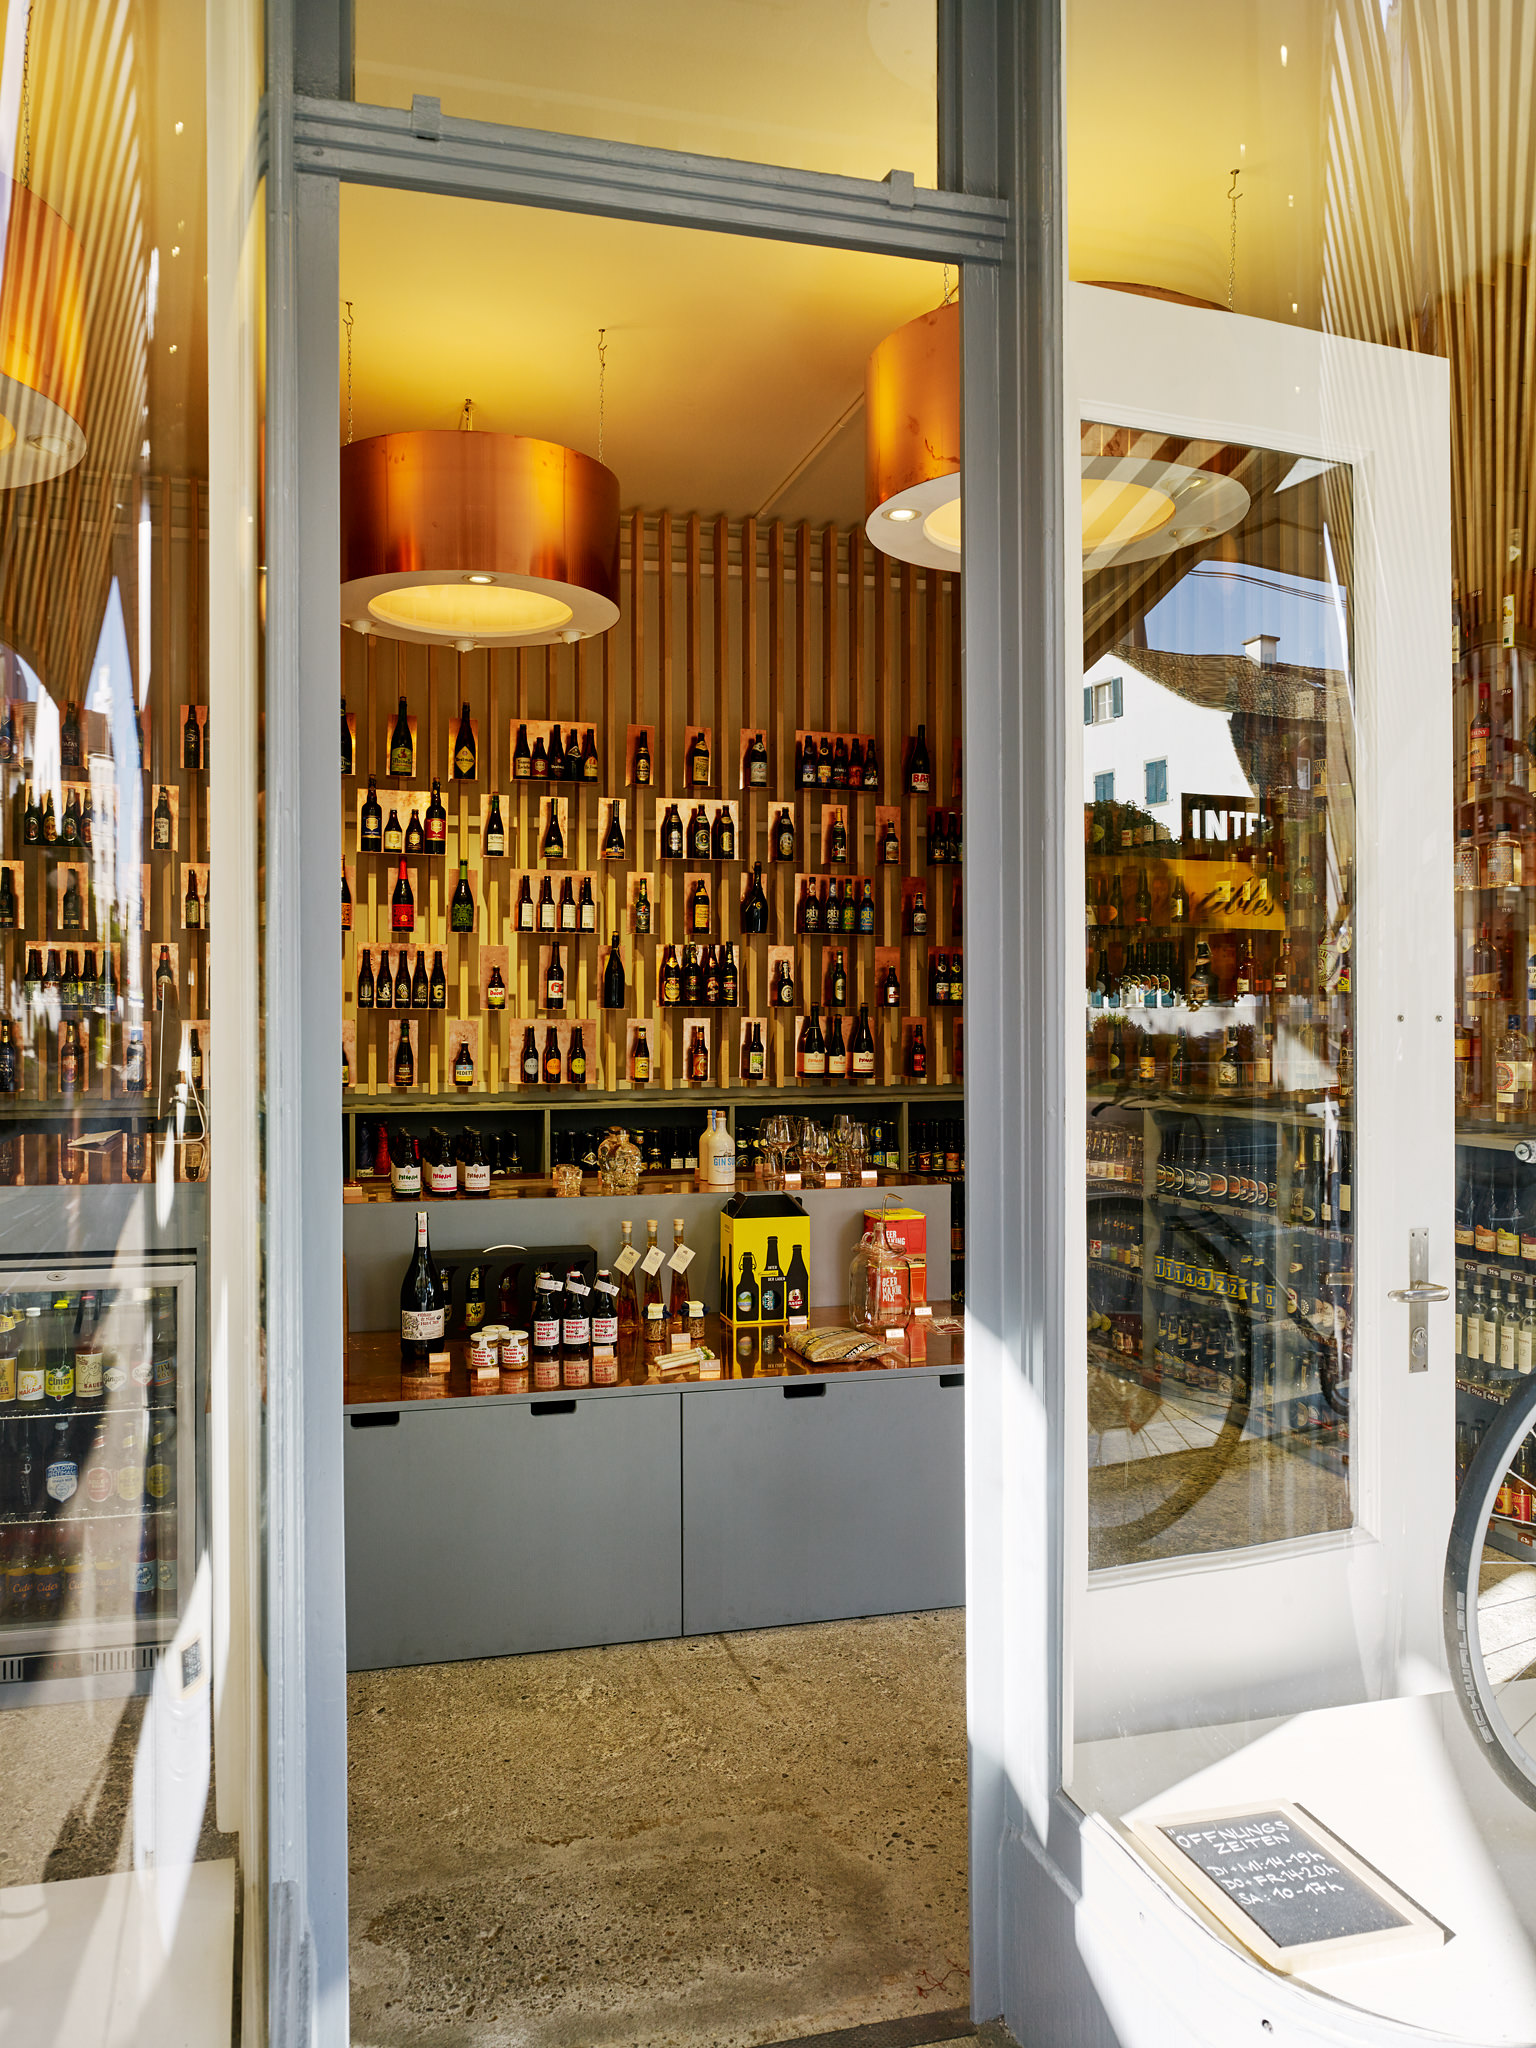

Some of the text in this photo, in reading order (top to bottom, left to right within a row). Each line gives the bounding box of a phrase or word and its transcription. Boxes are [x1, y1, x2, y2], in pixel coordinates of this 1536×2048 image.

[714, 1158, 726, 1166] GIN
[882, 1276, 898, 1287] BEER
[37, 1582, 58, 1593] Cider
[1456, 1591, 1495, 1744] SCHWALBE
[1213, 1833, 1291, 1855] ZEITEN
